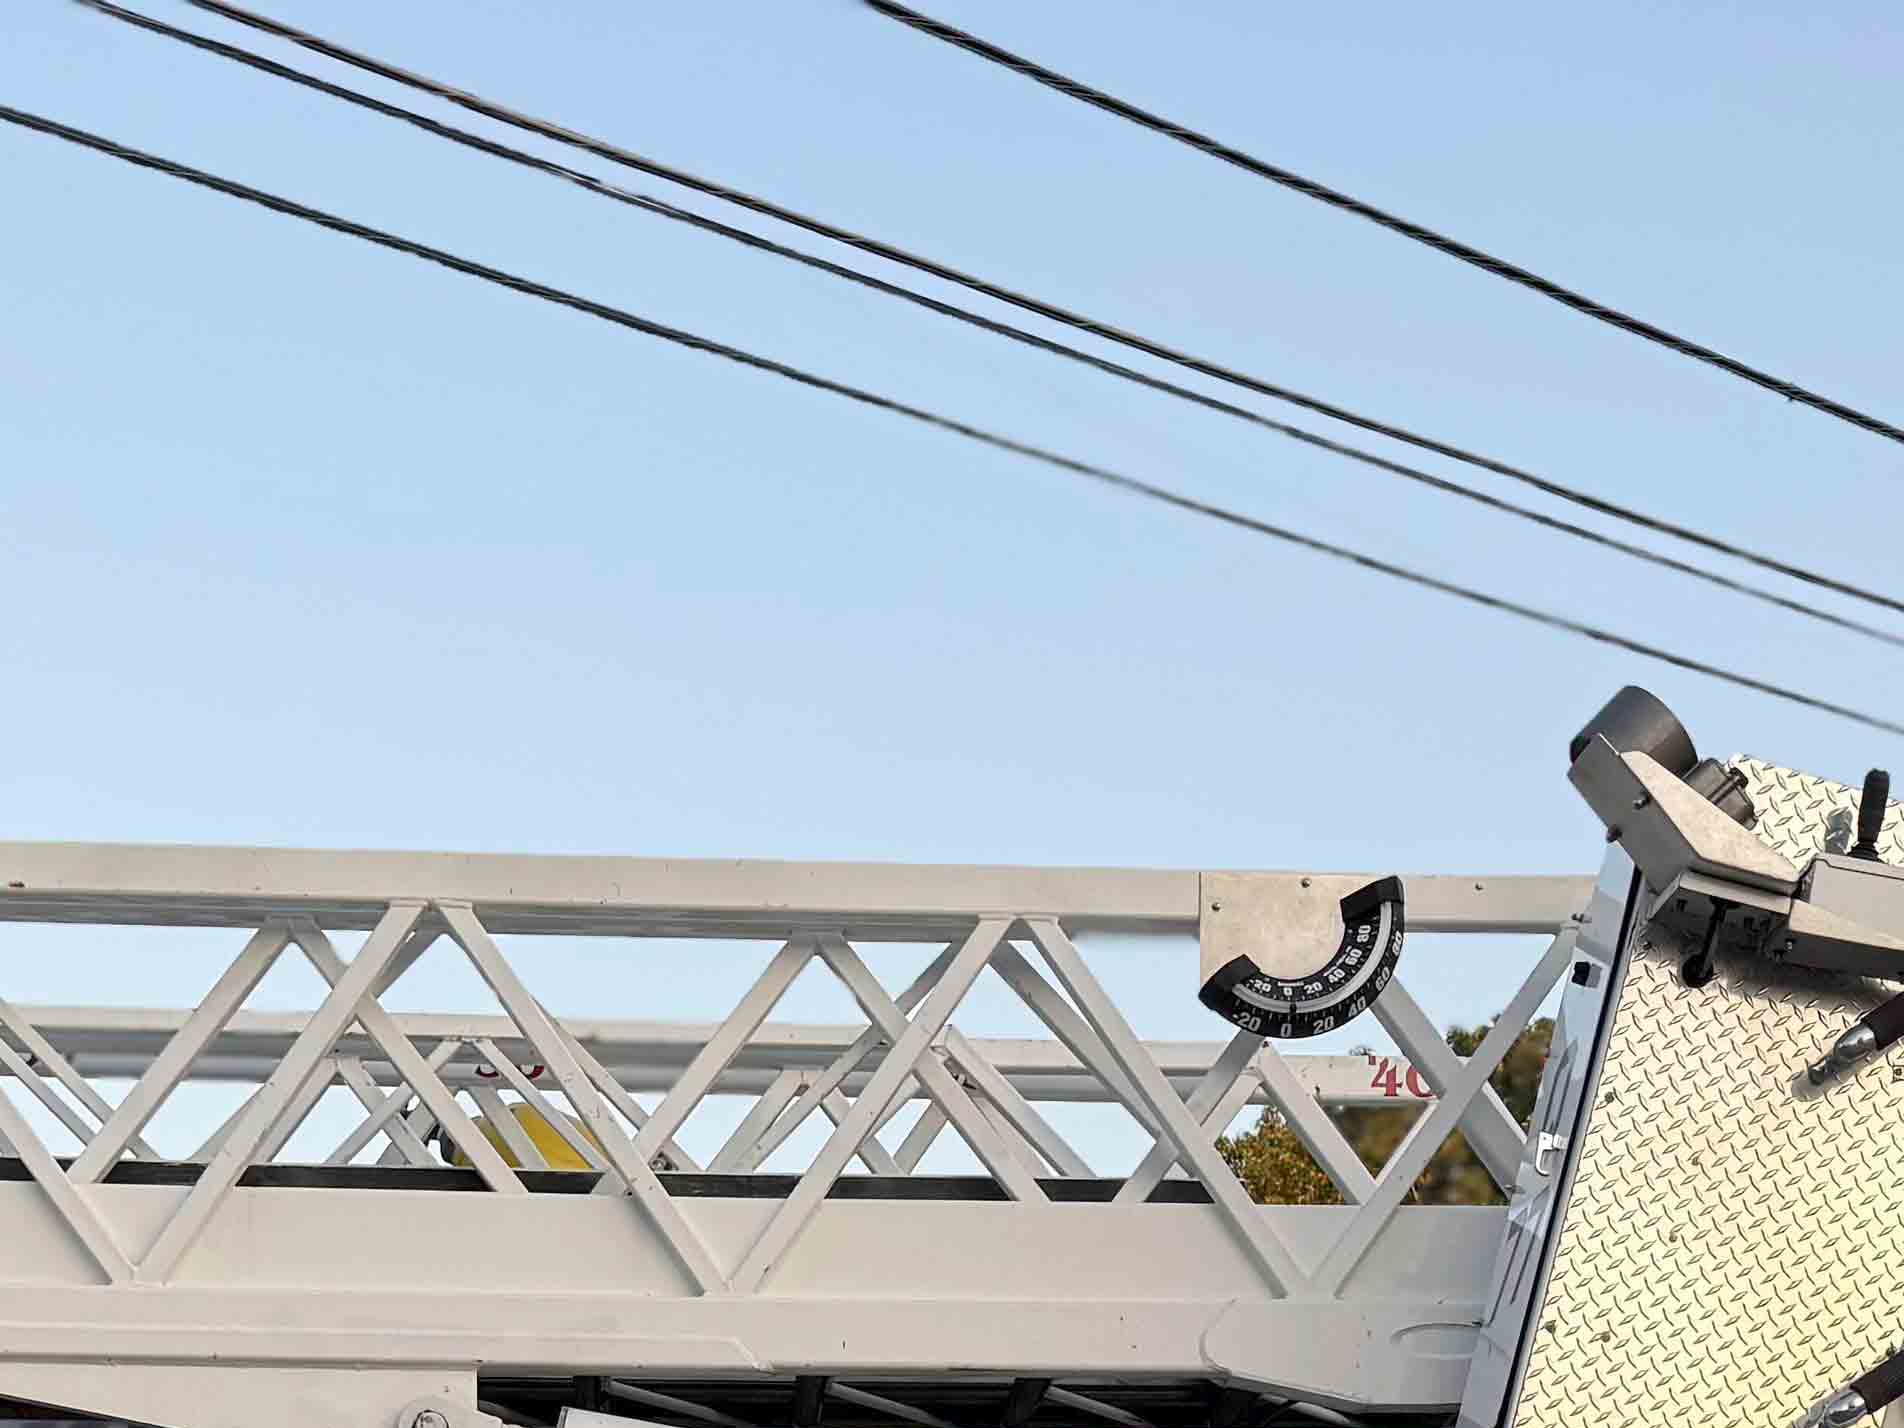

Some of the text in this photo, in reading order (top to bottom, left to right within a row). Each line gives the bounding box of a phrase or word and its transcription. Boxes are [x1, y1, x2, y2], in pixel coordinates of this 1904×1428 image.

[1283, 986, 1293, 997] 0
[1303, 981, 1324, 995] 20
[1328, 968, 1345, 984] 40
[1344, 948, 1363, 966] 60
[1356, 925, 1372, 943] 80
[1232, 1012, 1262, 1032] -20
[1280, 1023, 1292, 1038] 0
[1313, 1015, 1335, 1035] 20
[1348, 996, 1366, 1018] 40
[1375, 966, 1390, 991] 60
